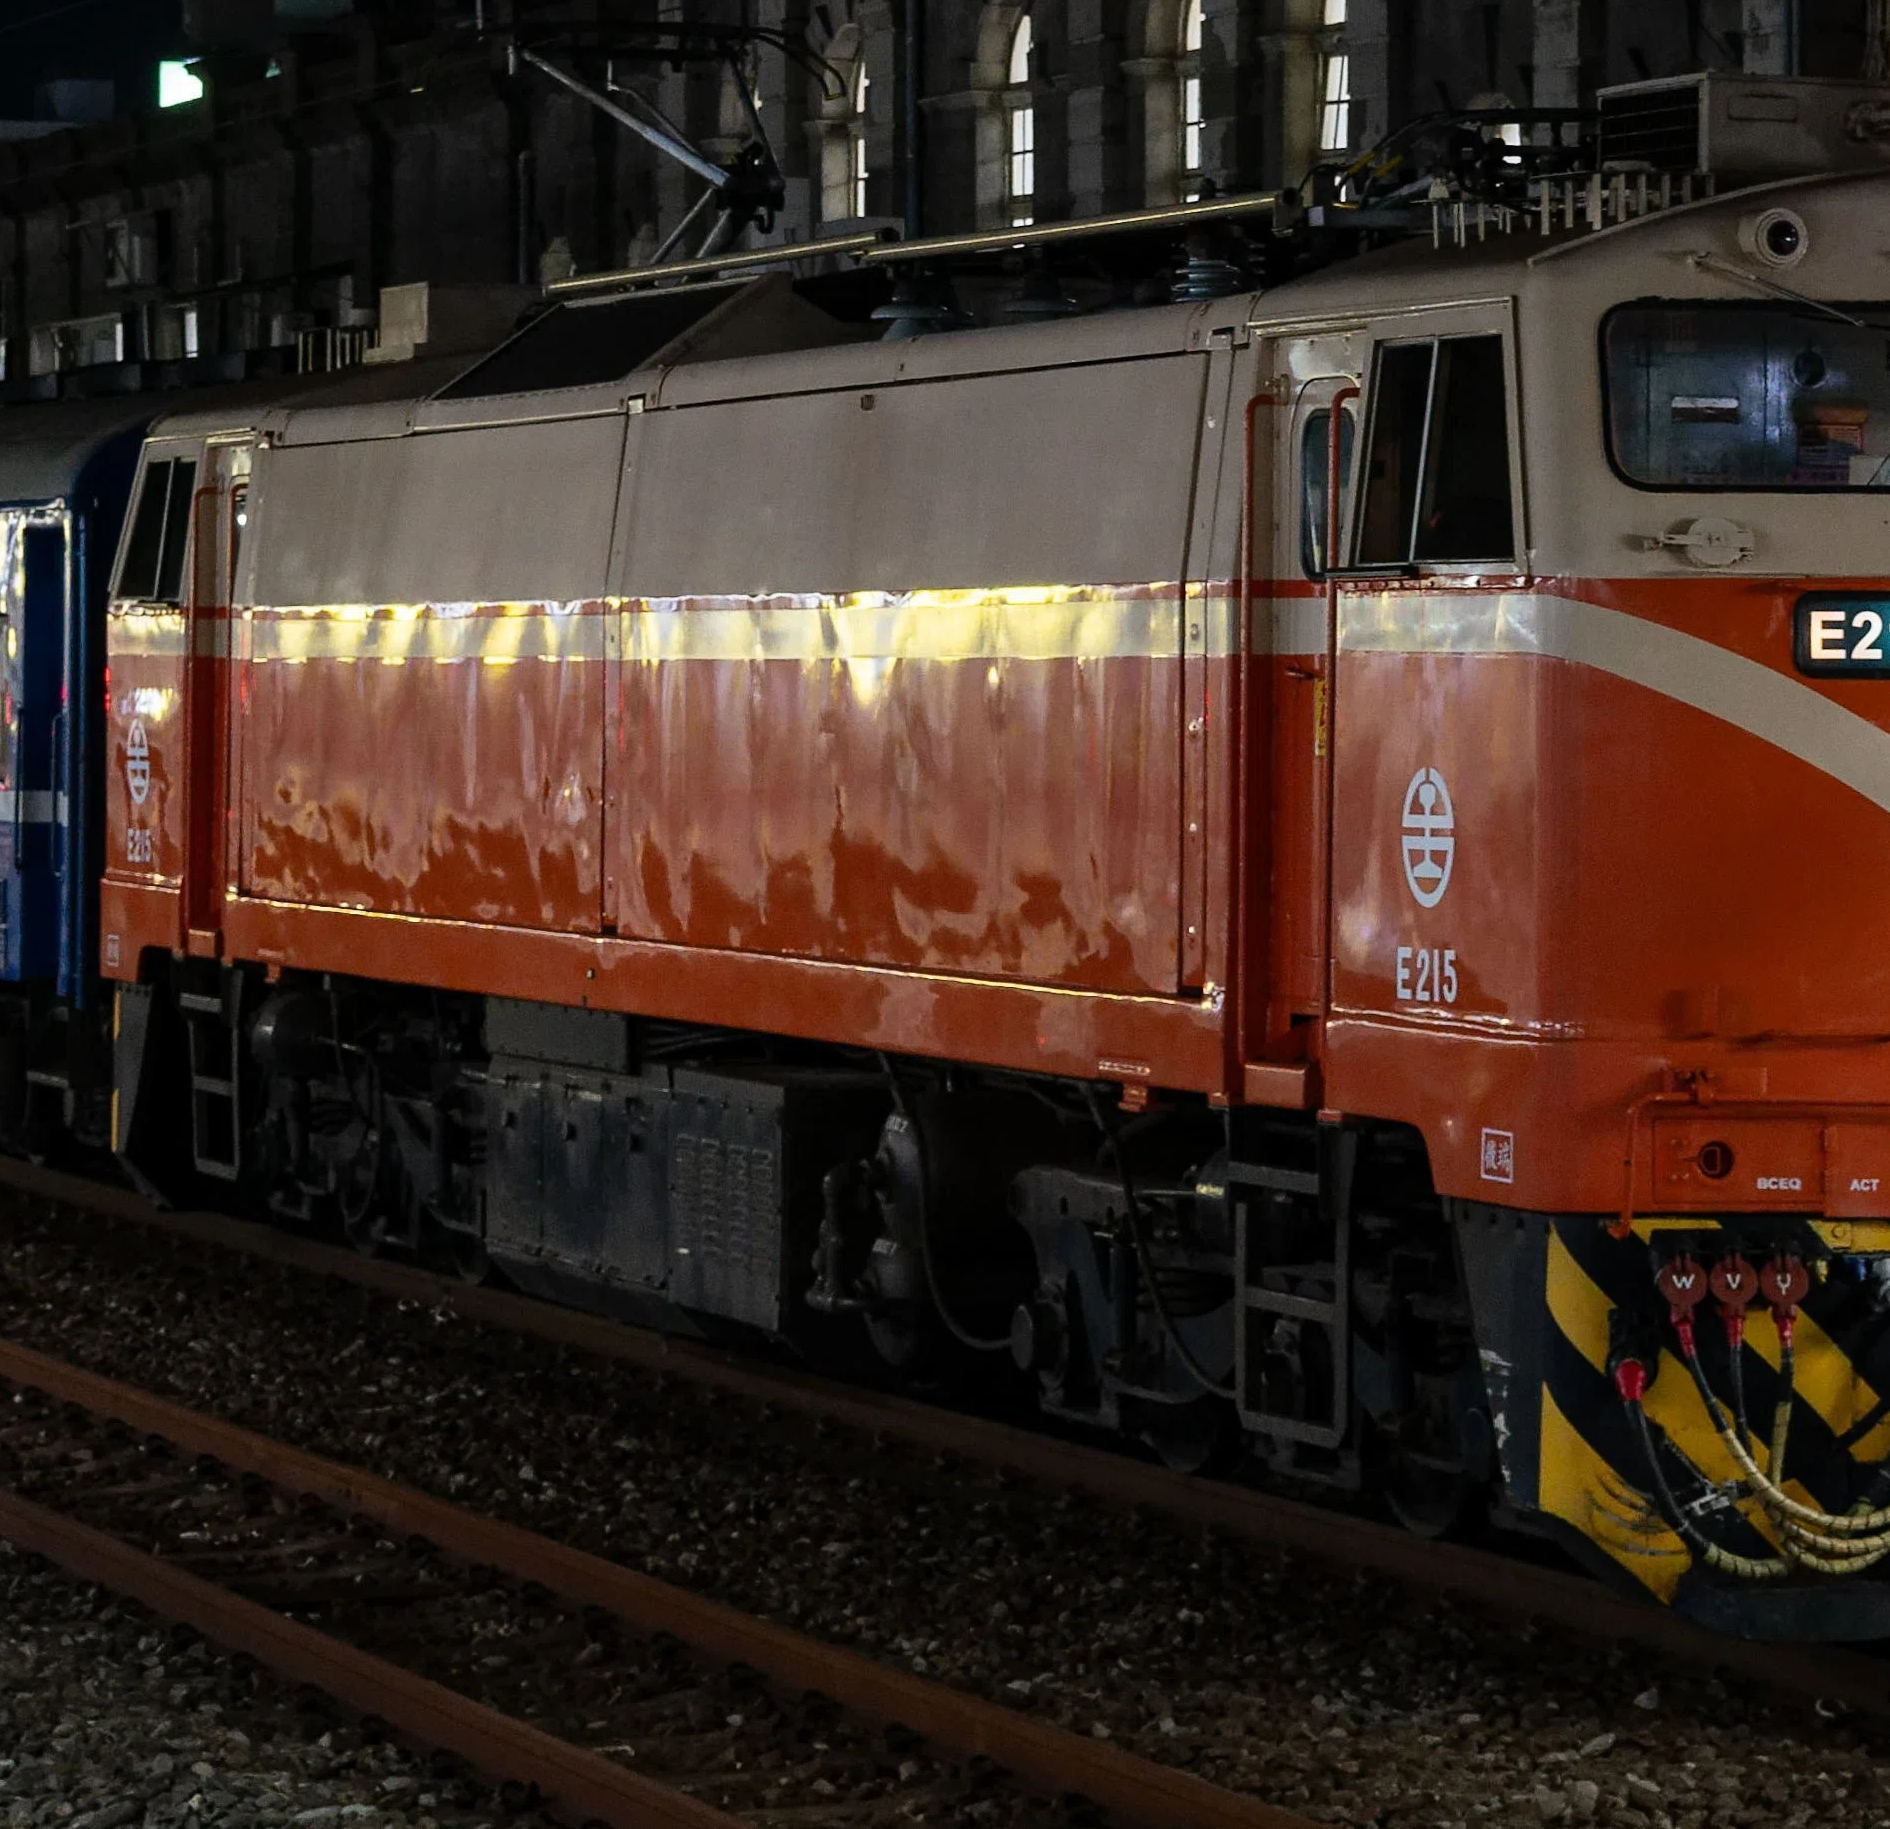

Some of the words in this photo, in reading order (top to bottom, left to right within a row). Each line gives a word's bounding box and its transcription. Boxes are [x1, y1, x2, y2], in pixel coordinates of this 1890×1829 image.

[1396, 946, 1458, 1003] E215
[1756, 1176, 1803, 1191] BCEQ
[1849, 1178, 1880, 1192] ACT
[1671, 1273, 1696, 1290] W
[1726, 1273, 1742, 1290] V
